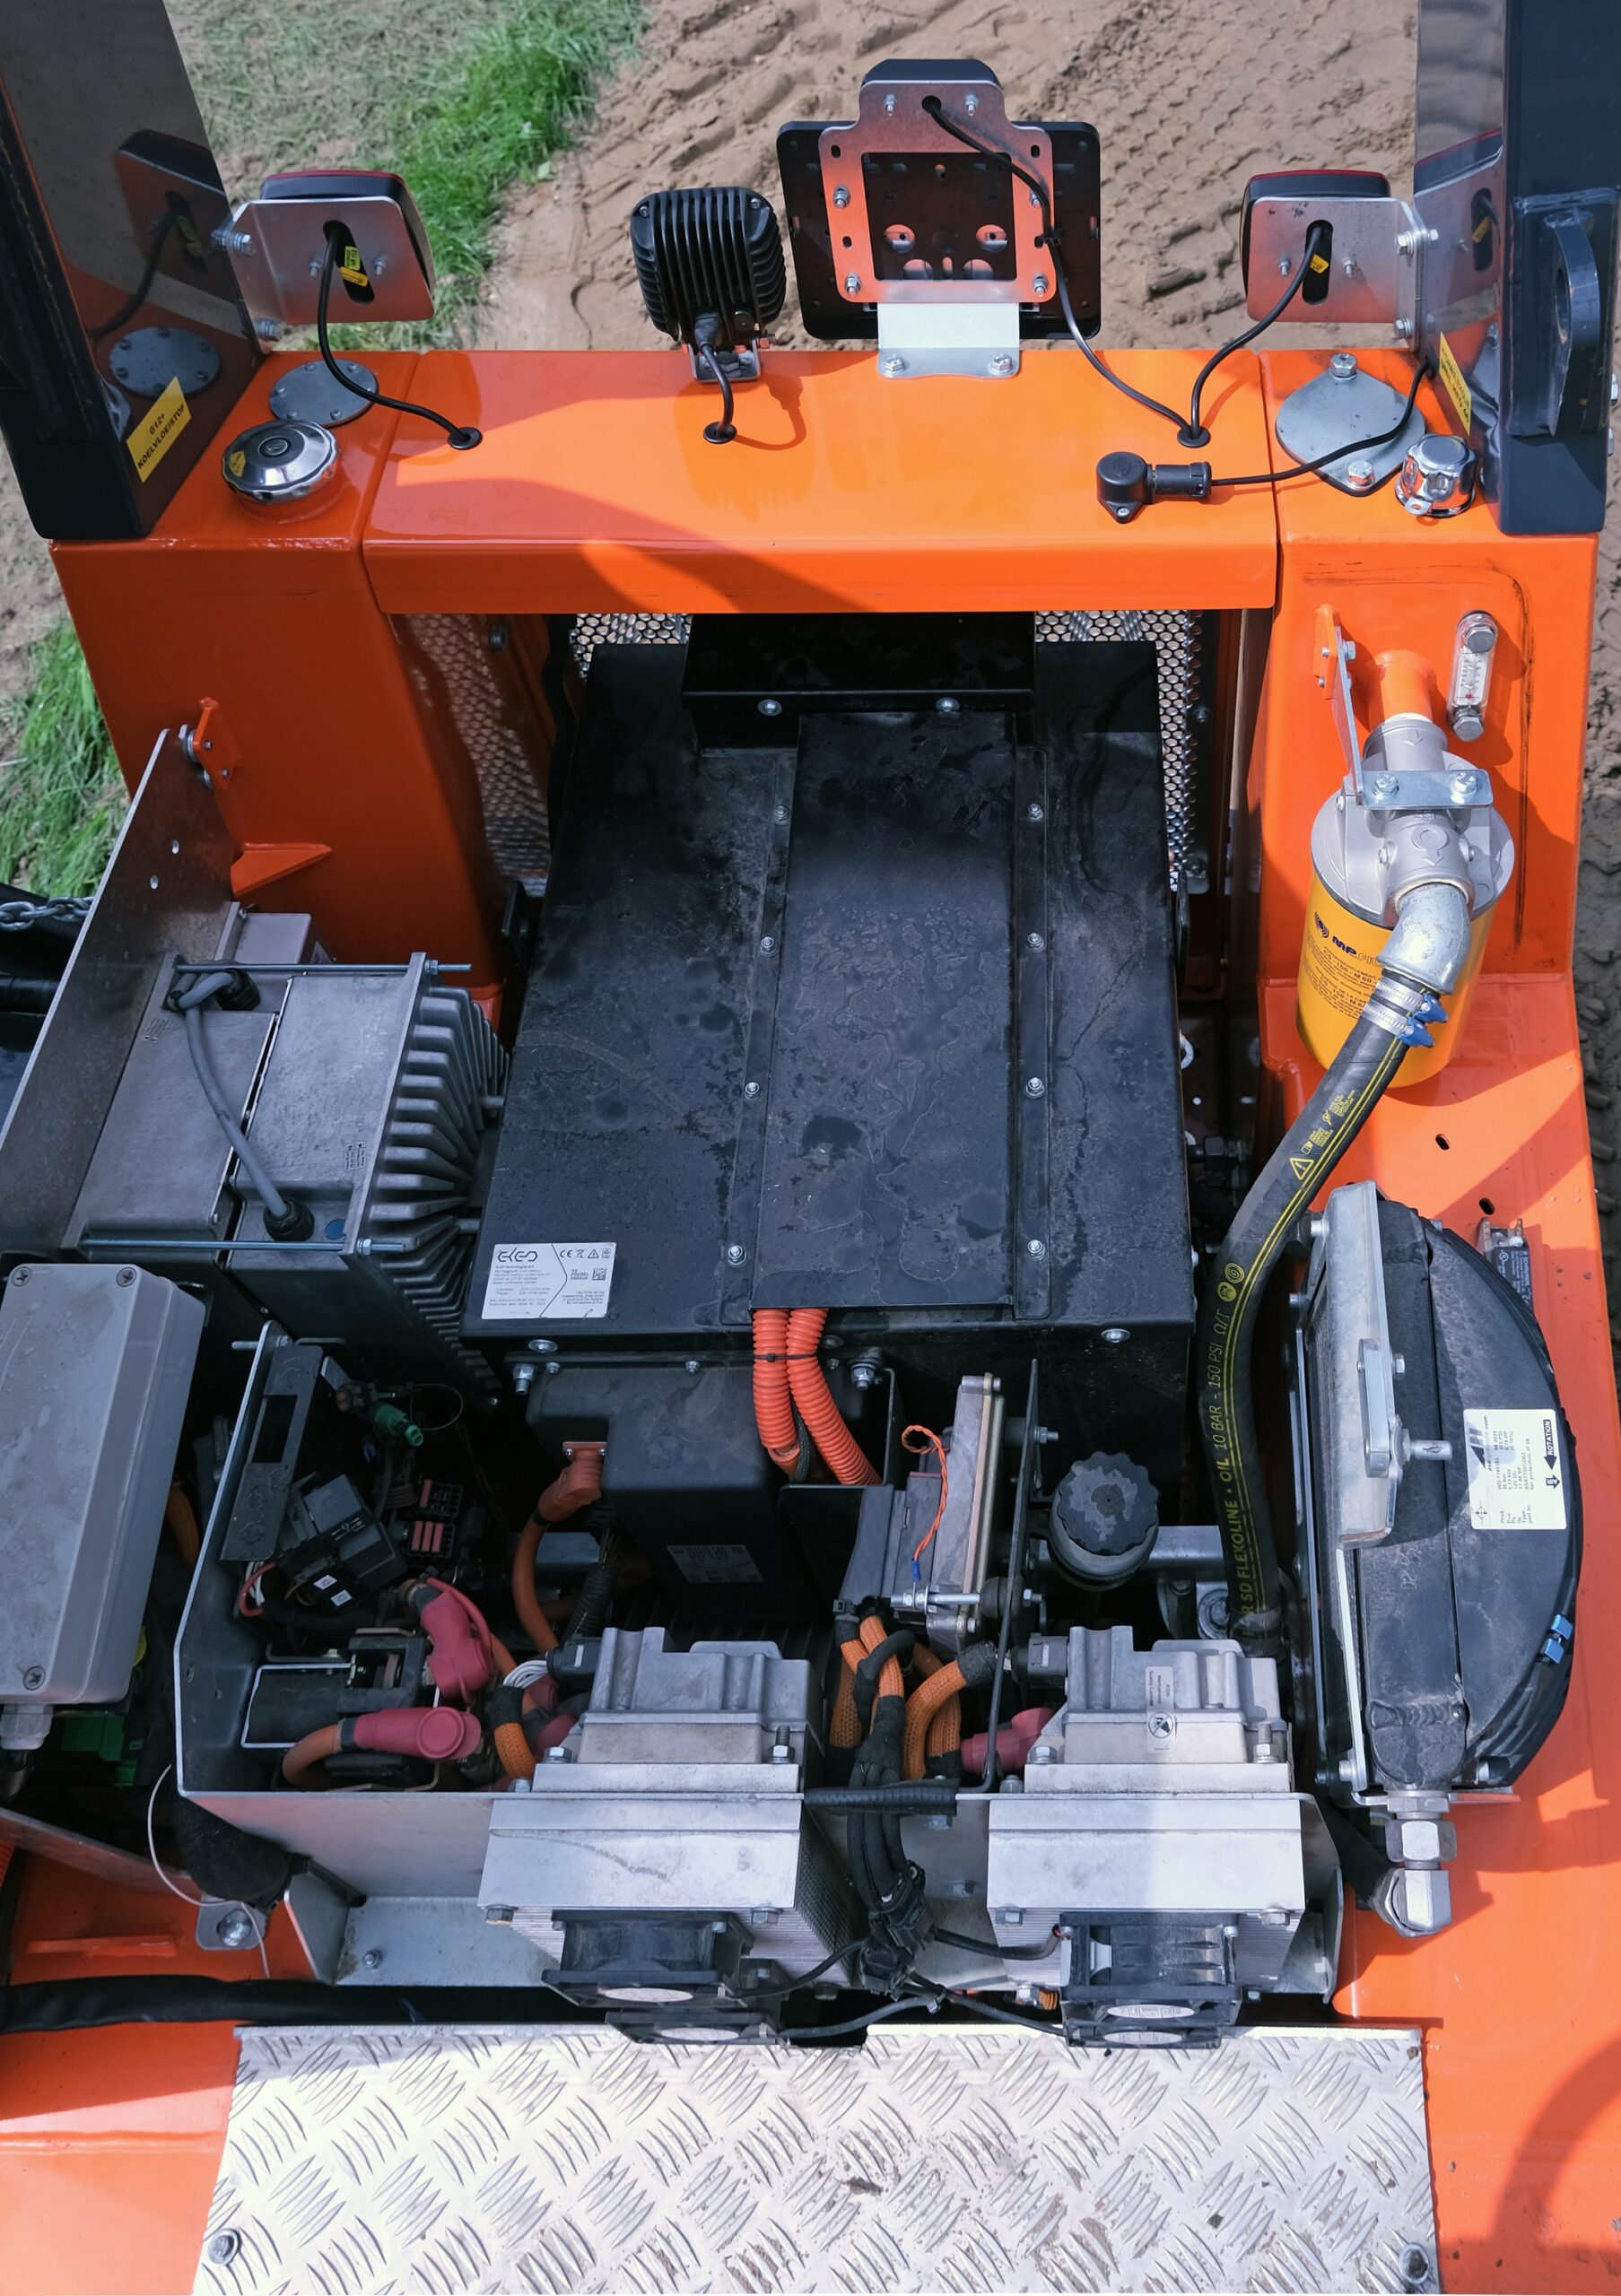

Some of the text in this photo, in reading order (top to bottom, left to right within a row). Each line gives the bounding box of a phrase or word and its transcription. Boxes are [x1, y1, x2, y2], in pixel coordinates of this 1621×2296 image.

[149, 413, 165, 435] G12+
[137, 403, 186, 469] KOELVLOEISTOF
[1332, 935, 1357, 957] MP
[1208, 1342, 1224, 1365] PSI
[1208, 1365, 1222, 1388] 150
[1208, 1405, 1224, 1431] BAR
[1213, 1434, 1227, 1450] 10
[1544, 1421, 1554, 1456] ROTATION
[1216, 1458, 1232, 1482] OIL
[1224, 1500, 1251, 1580] FLEXOLINE
[1240, 1582, 1253, 1601] SD
